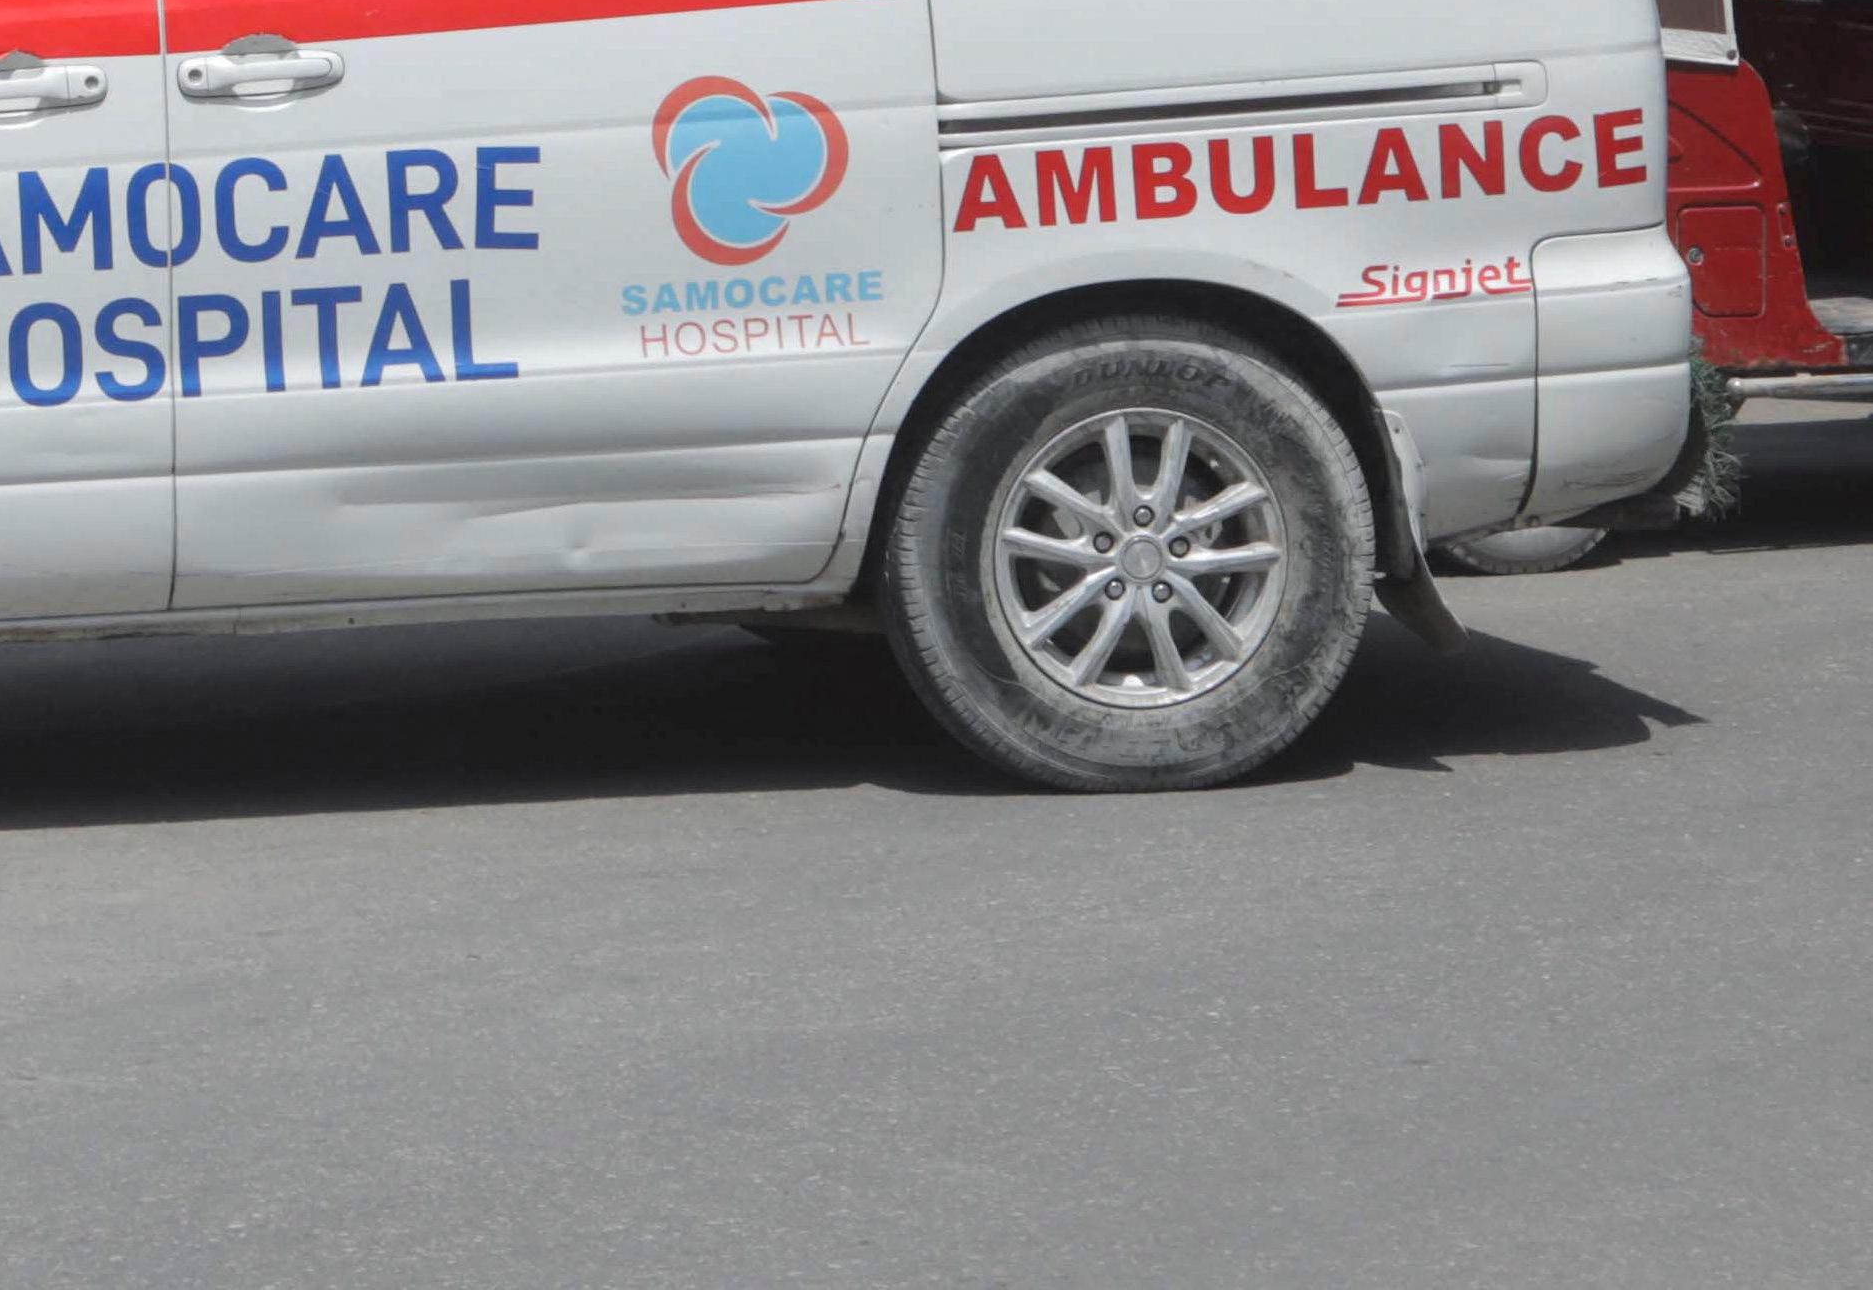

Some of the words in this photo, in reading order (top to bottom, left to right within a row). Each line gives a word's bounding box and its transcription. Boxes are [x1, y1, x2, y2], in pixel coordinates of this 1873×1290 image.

[952, 107, 1649, 234] AMBULANCE
[619, 270, 886, 318] SAMOCARE
[1339, 255, 1533, 307] Signjet
[639, 313, 873, 360] HOSPITAL
